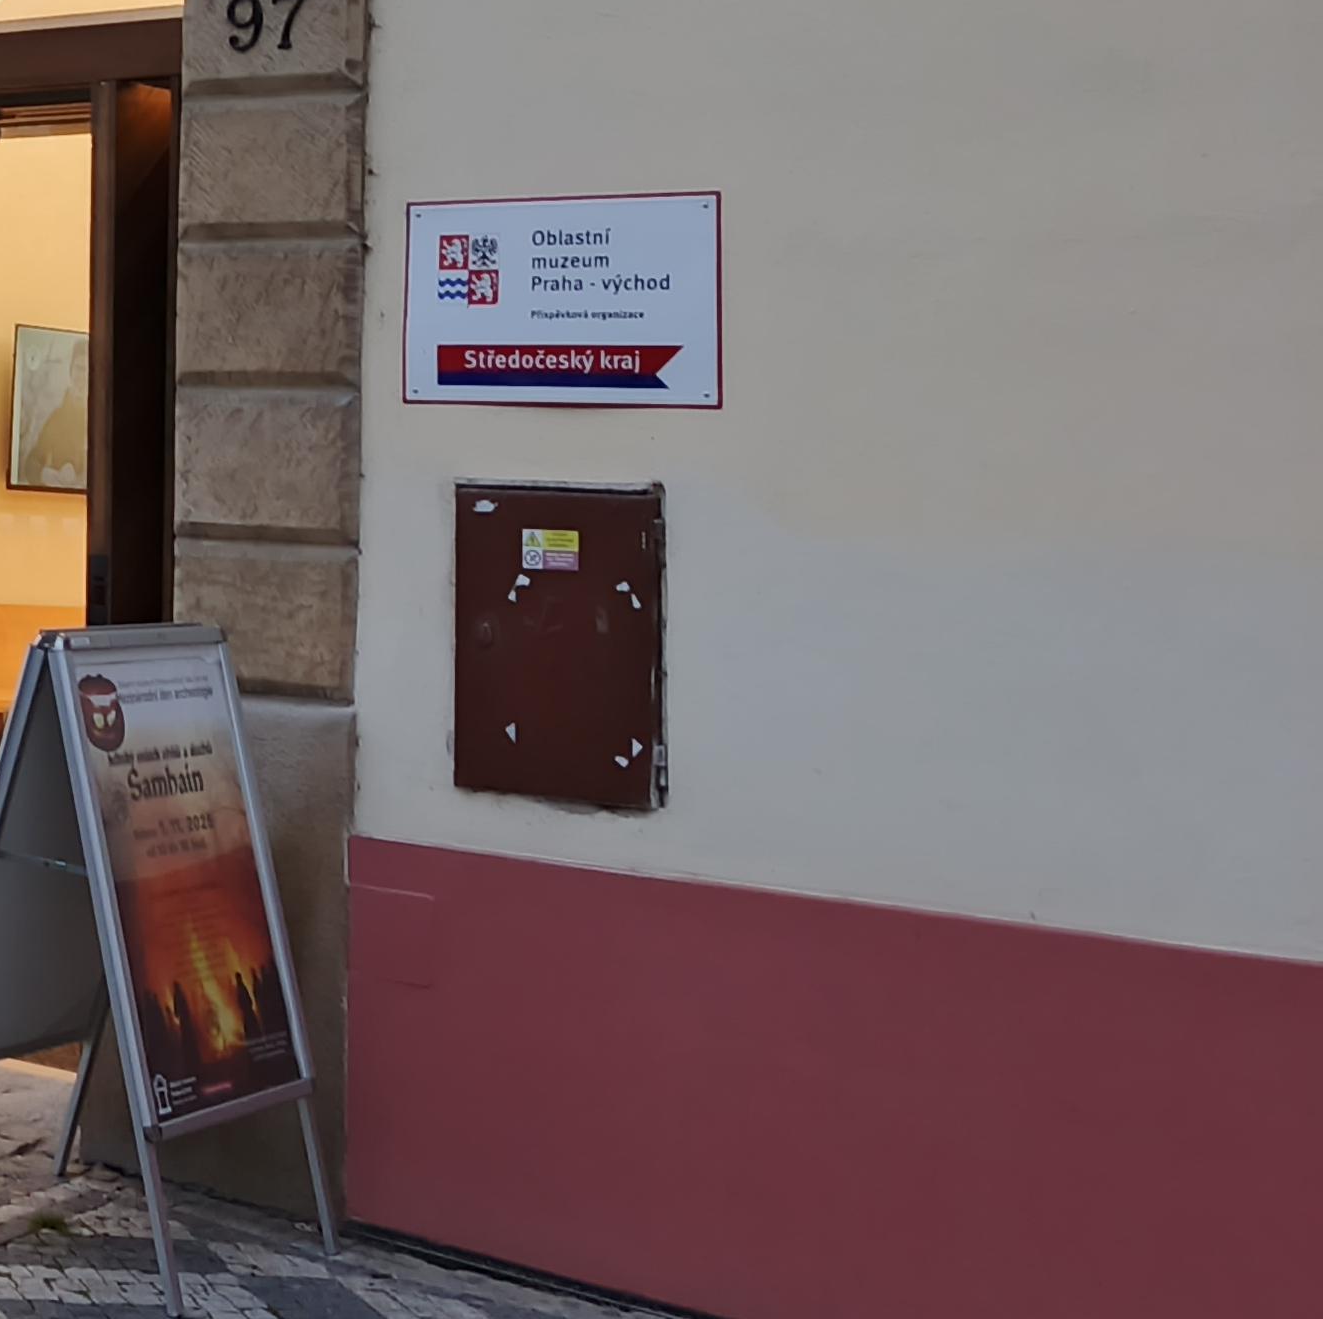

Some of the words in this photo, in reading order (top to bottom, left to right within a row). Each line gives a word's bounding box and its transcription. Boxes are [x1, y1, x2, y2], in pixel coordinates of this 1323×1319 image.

[531, 227, 612, 247] Oblastní
[531, 255, 610, 269] muzeum
[531, 275, 583, 292] Praha
[602, 274, 670, 295] východ
[590, 311, 644, 321] organizace
[464, 349, 594, 374] Středočeský
[600, 350, 640, 374] kraj
[127, 763, 204, 801] Samhain
